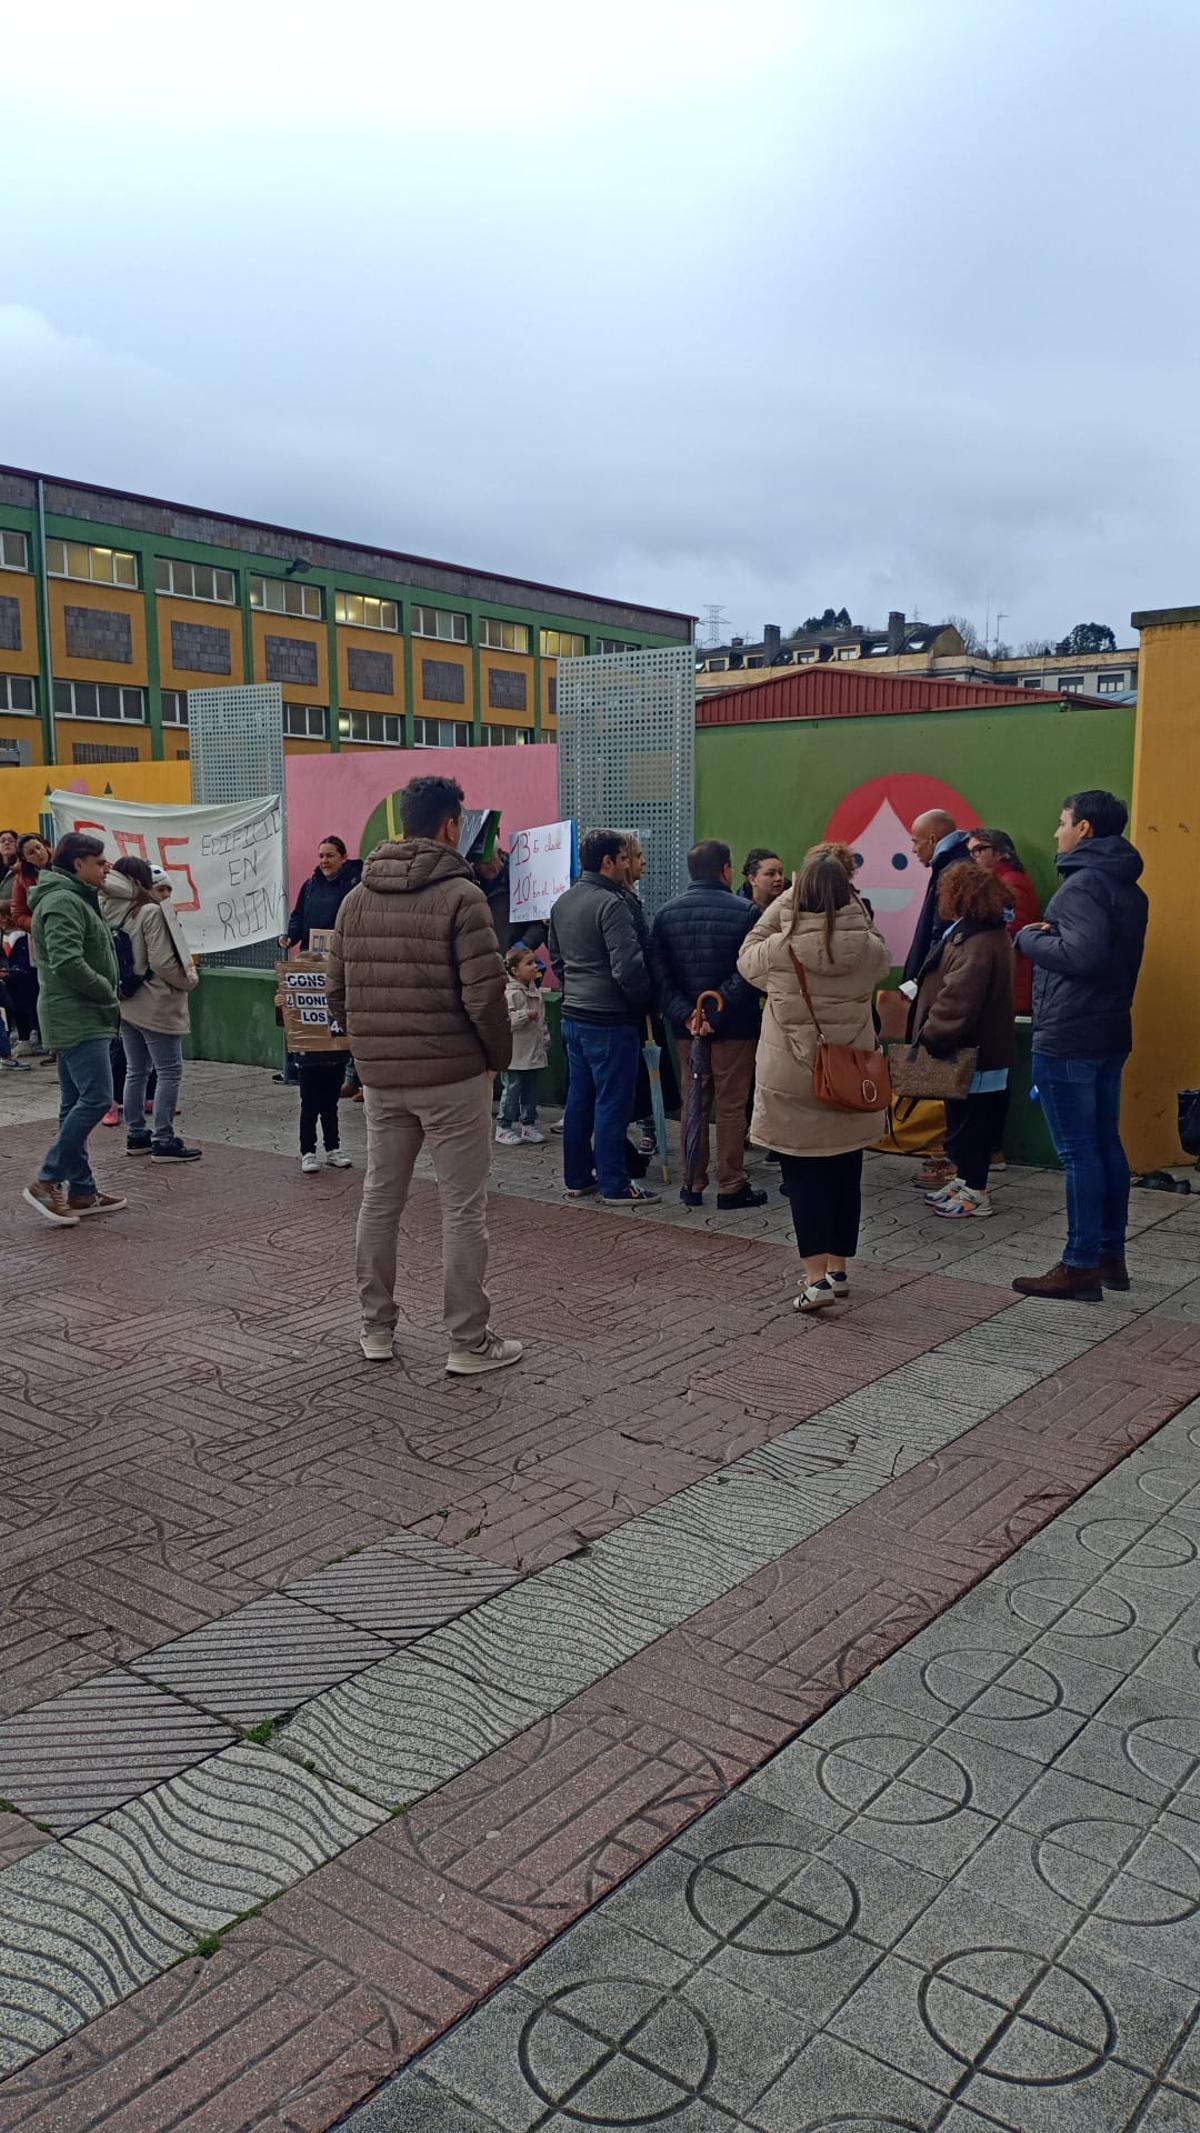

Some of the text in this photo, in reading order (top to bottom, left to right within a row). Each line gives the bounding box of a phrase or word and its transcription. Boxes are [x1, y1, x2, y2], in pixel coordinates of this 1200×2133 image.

[74, 821, 200, 912] OS
[228, 850, 258, 886] EN
[217, 882, 287, 940] RUINA
[302, 1011, 326, 1023] LOS
